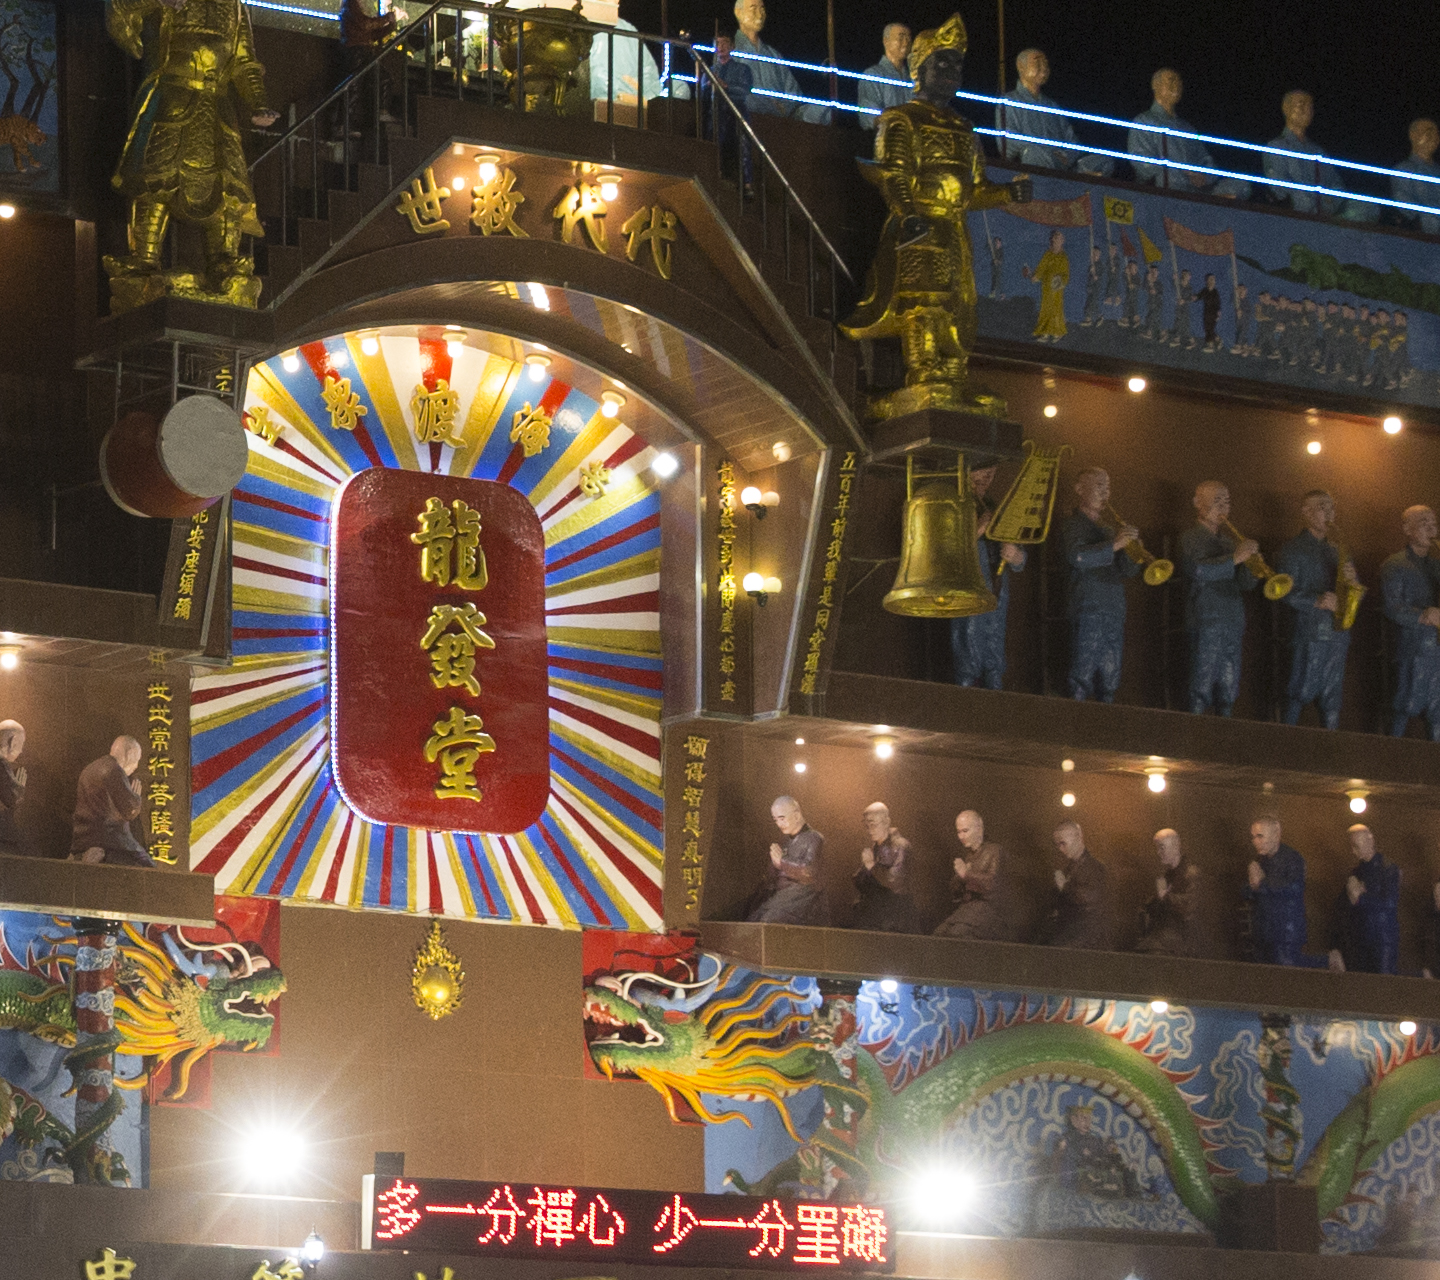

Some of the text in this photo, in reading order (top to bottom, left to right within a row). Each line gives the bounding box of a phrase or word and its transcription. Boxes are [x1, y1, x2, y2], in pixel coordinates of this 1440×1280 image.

[411, 496, 496, 803] 龍發堂
[376, 1178, 626, 1248] 多一分禪心
